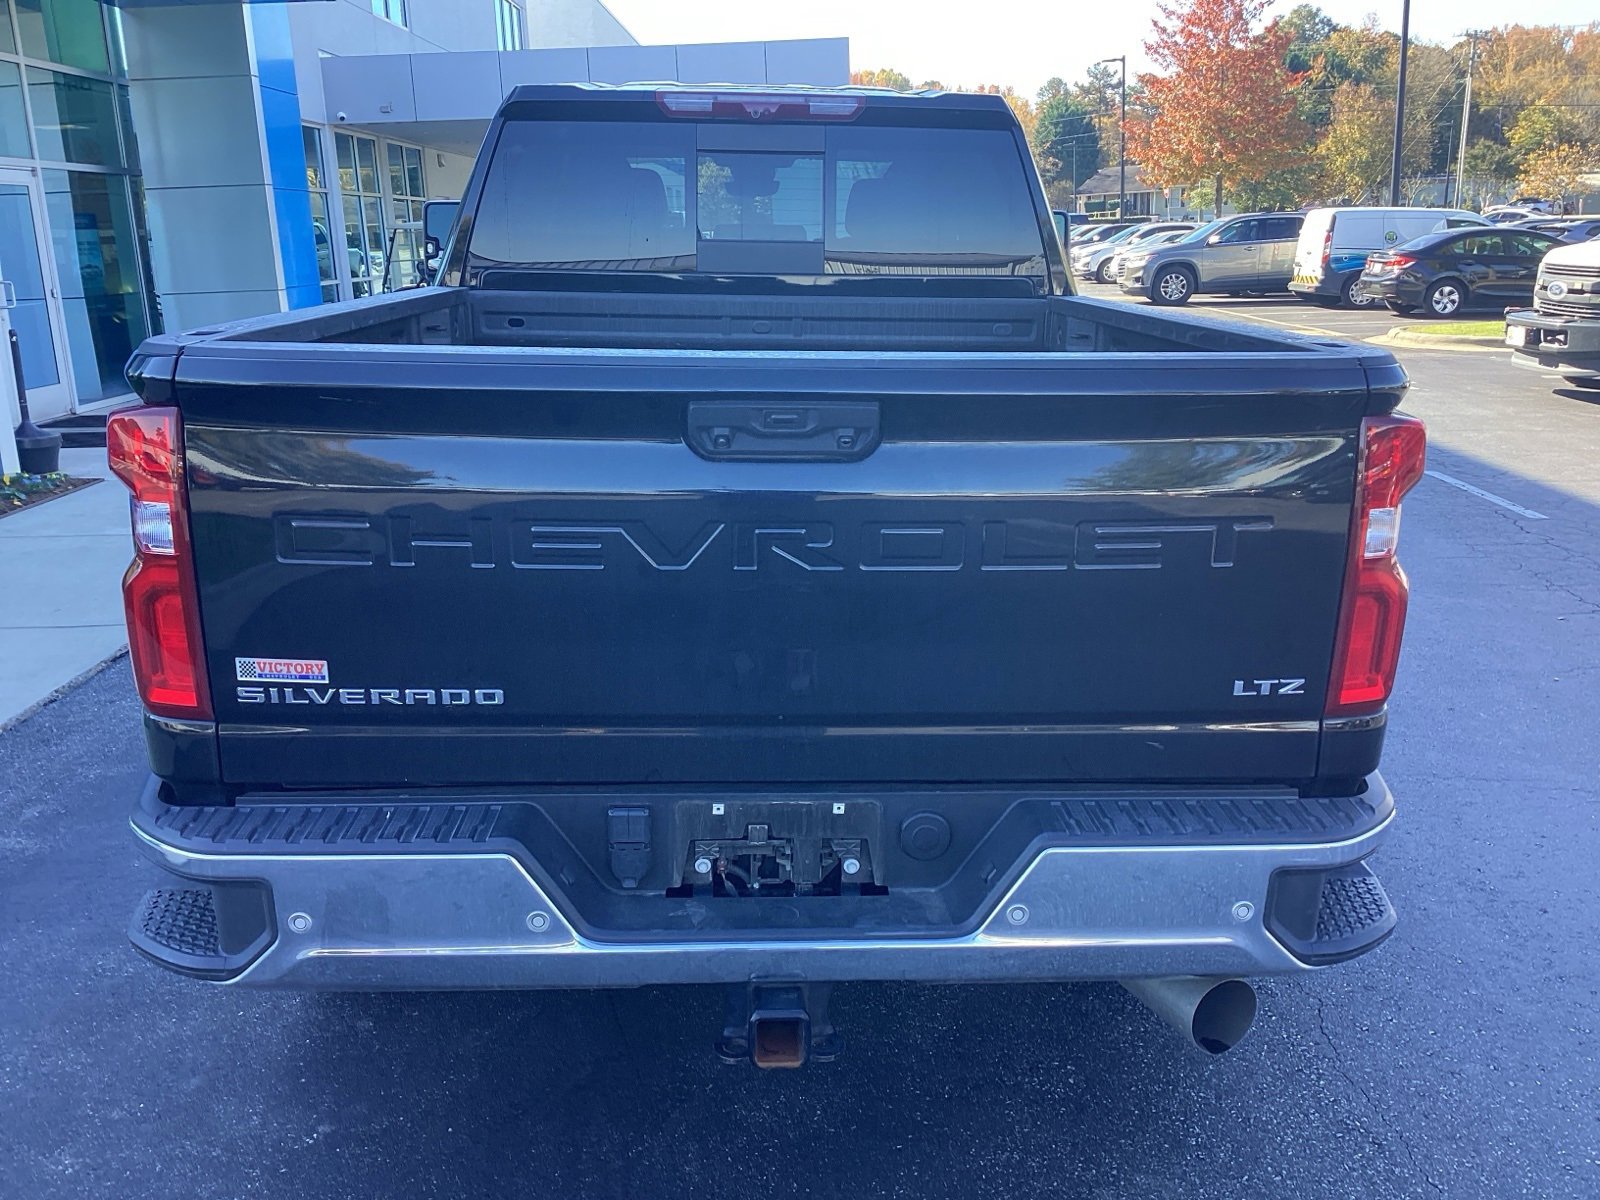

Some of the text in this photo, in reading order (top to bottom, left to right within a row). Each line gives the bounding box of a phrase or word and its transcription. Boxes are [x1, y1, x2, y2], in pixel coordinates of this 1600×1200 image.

[273, 512, 1275, 571] CHEVROLET
[256, 661, 325, 674] VICTORY
[236, 686, 505, 705] SILVERADO
[1233, 679, 1305, 696] LTZ
